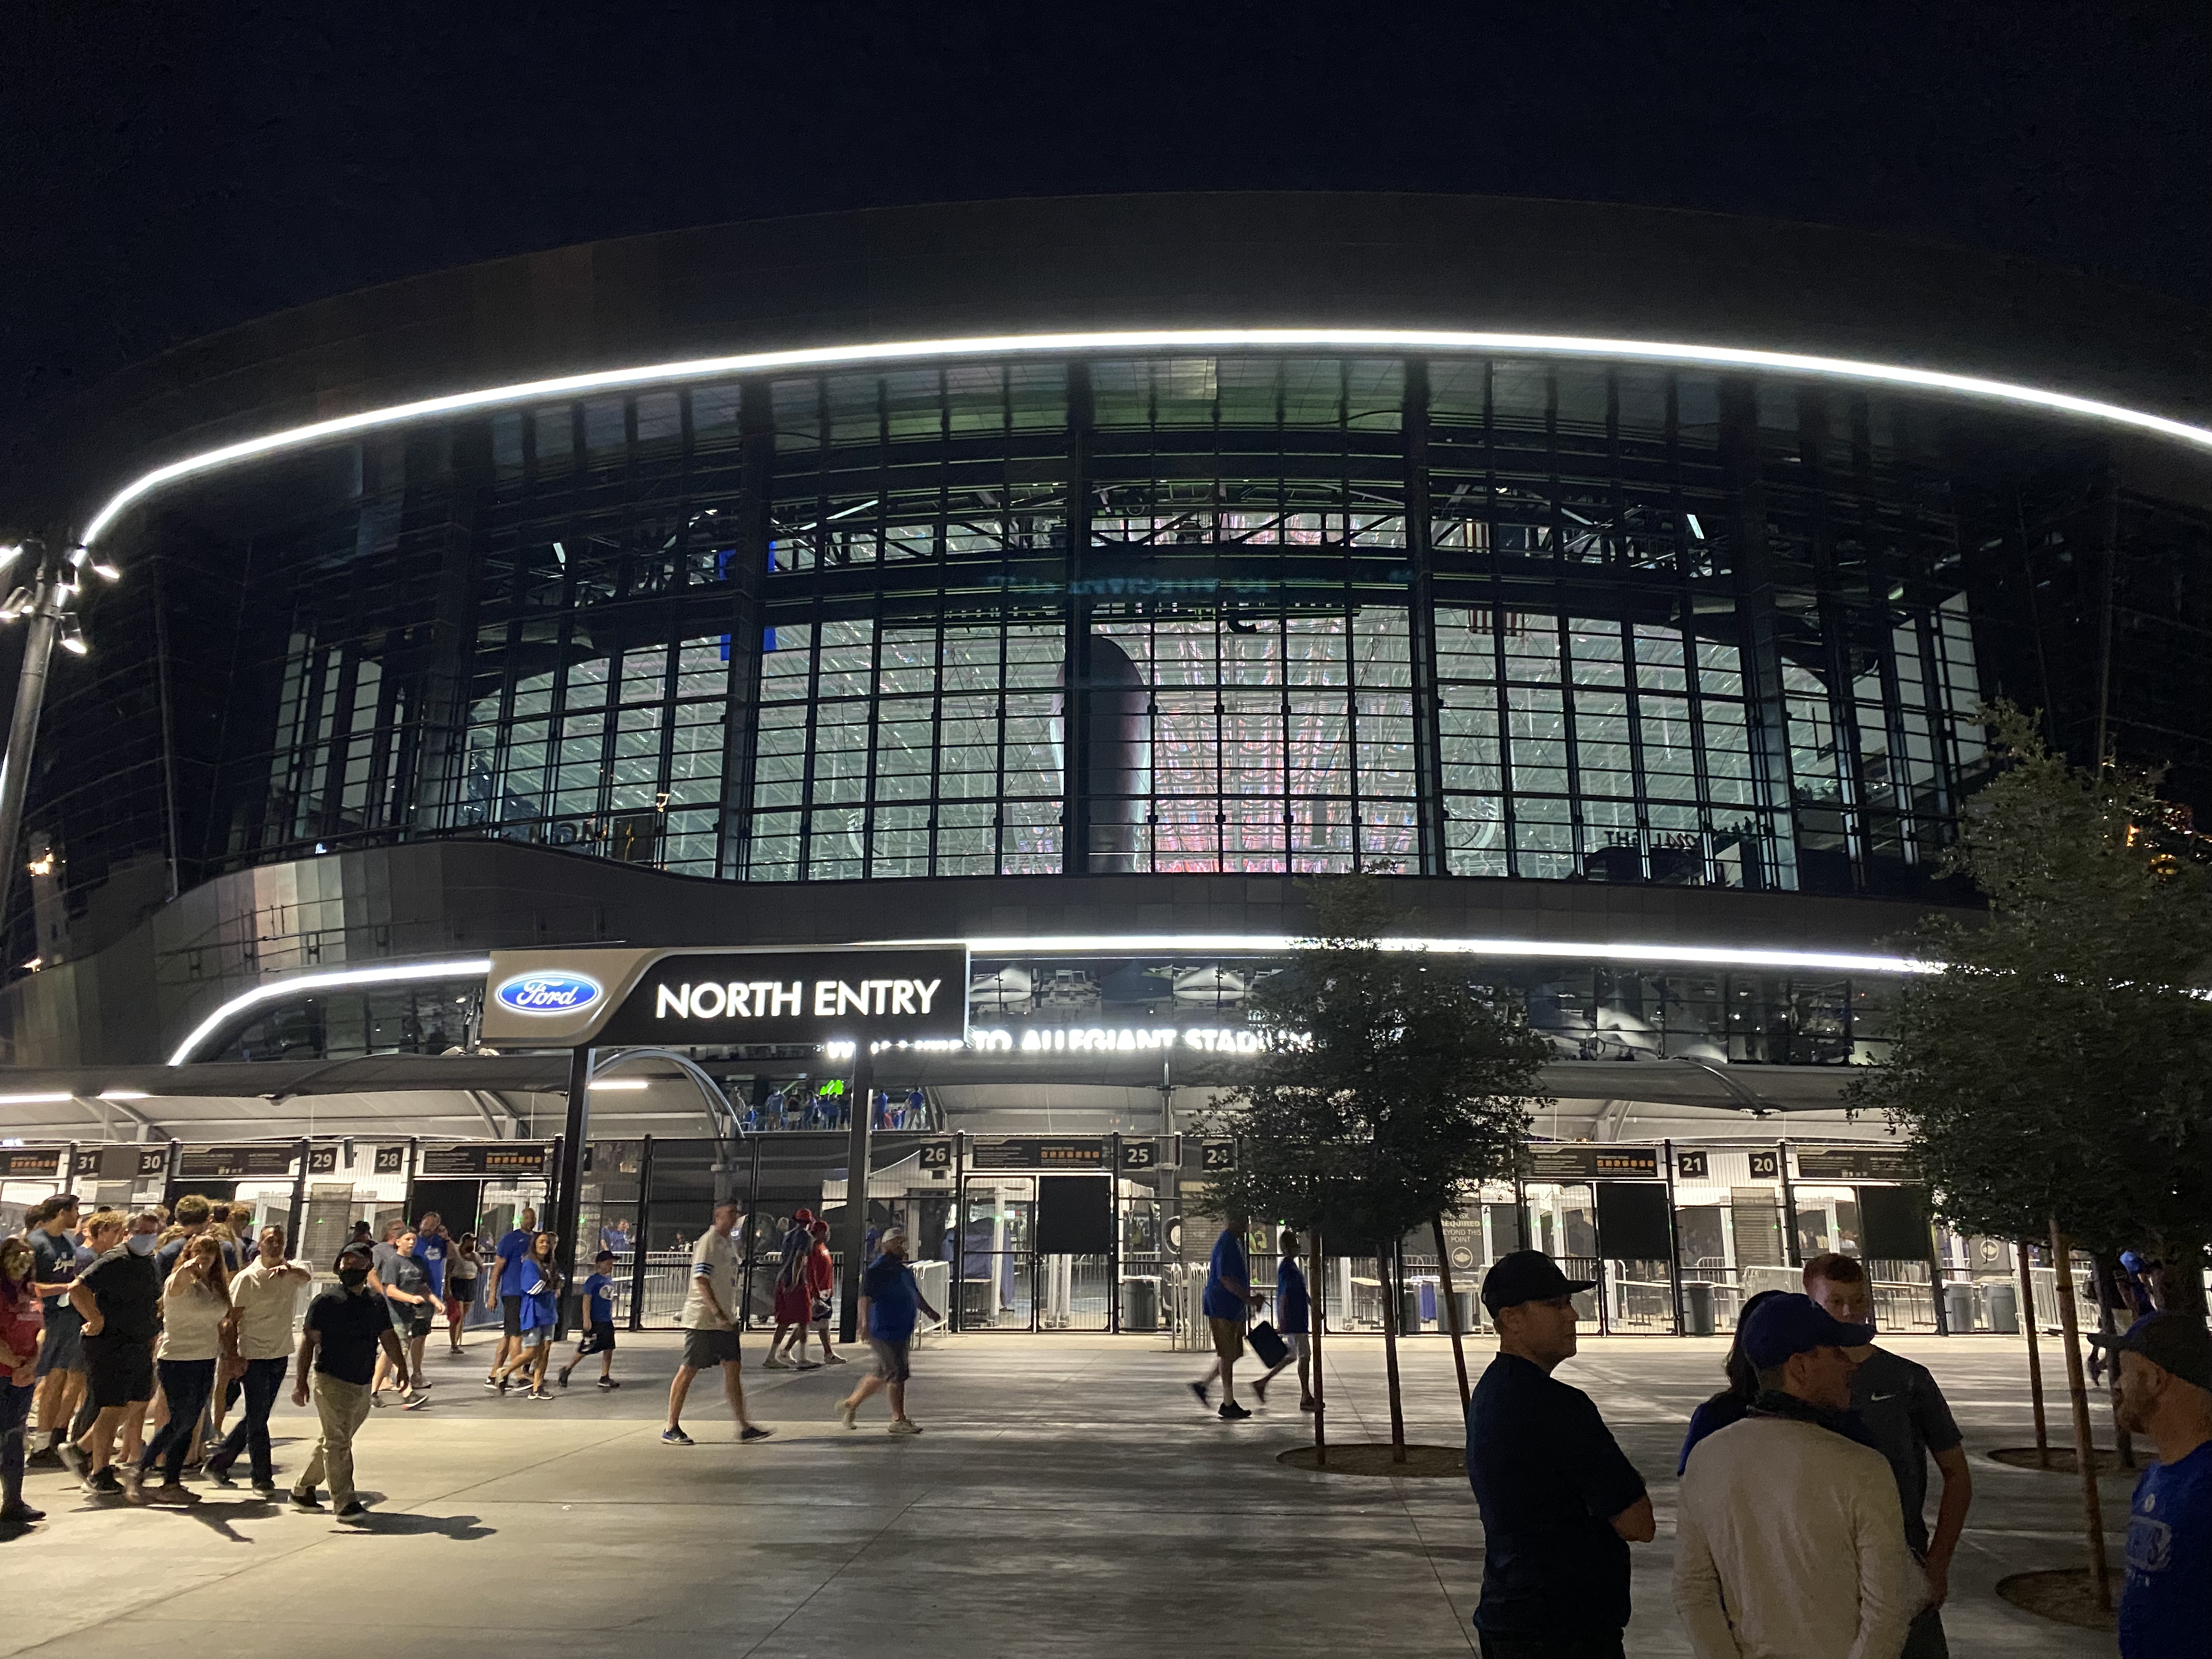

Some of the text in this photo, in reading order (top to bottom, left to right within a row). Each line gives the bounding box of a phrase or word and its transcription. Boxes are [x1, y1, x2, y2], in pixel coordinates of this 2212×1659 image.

[516, 980, 579, 1005] Ford
[657, 979, 941, 1018] NORTH ENTRY
[975, 1030, 1013, 1051] TO
[142, 1155, 161, 1169] 30
[313, 1153, 332, 1167] 29
[379, 1153, 398, 1167] 28
[924, 1148, 946, 1162] 26
[1127, 1148, 1149, 1163] 25
[78, 1156, 95, 1170] 31
[1683, 1157, 1702, 1171] 21
[1753, 1158, 1774, 1172] 20
